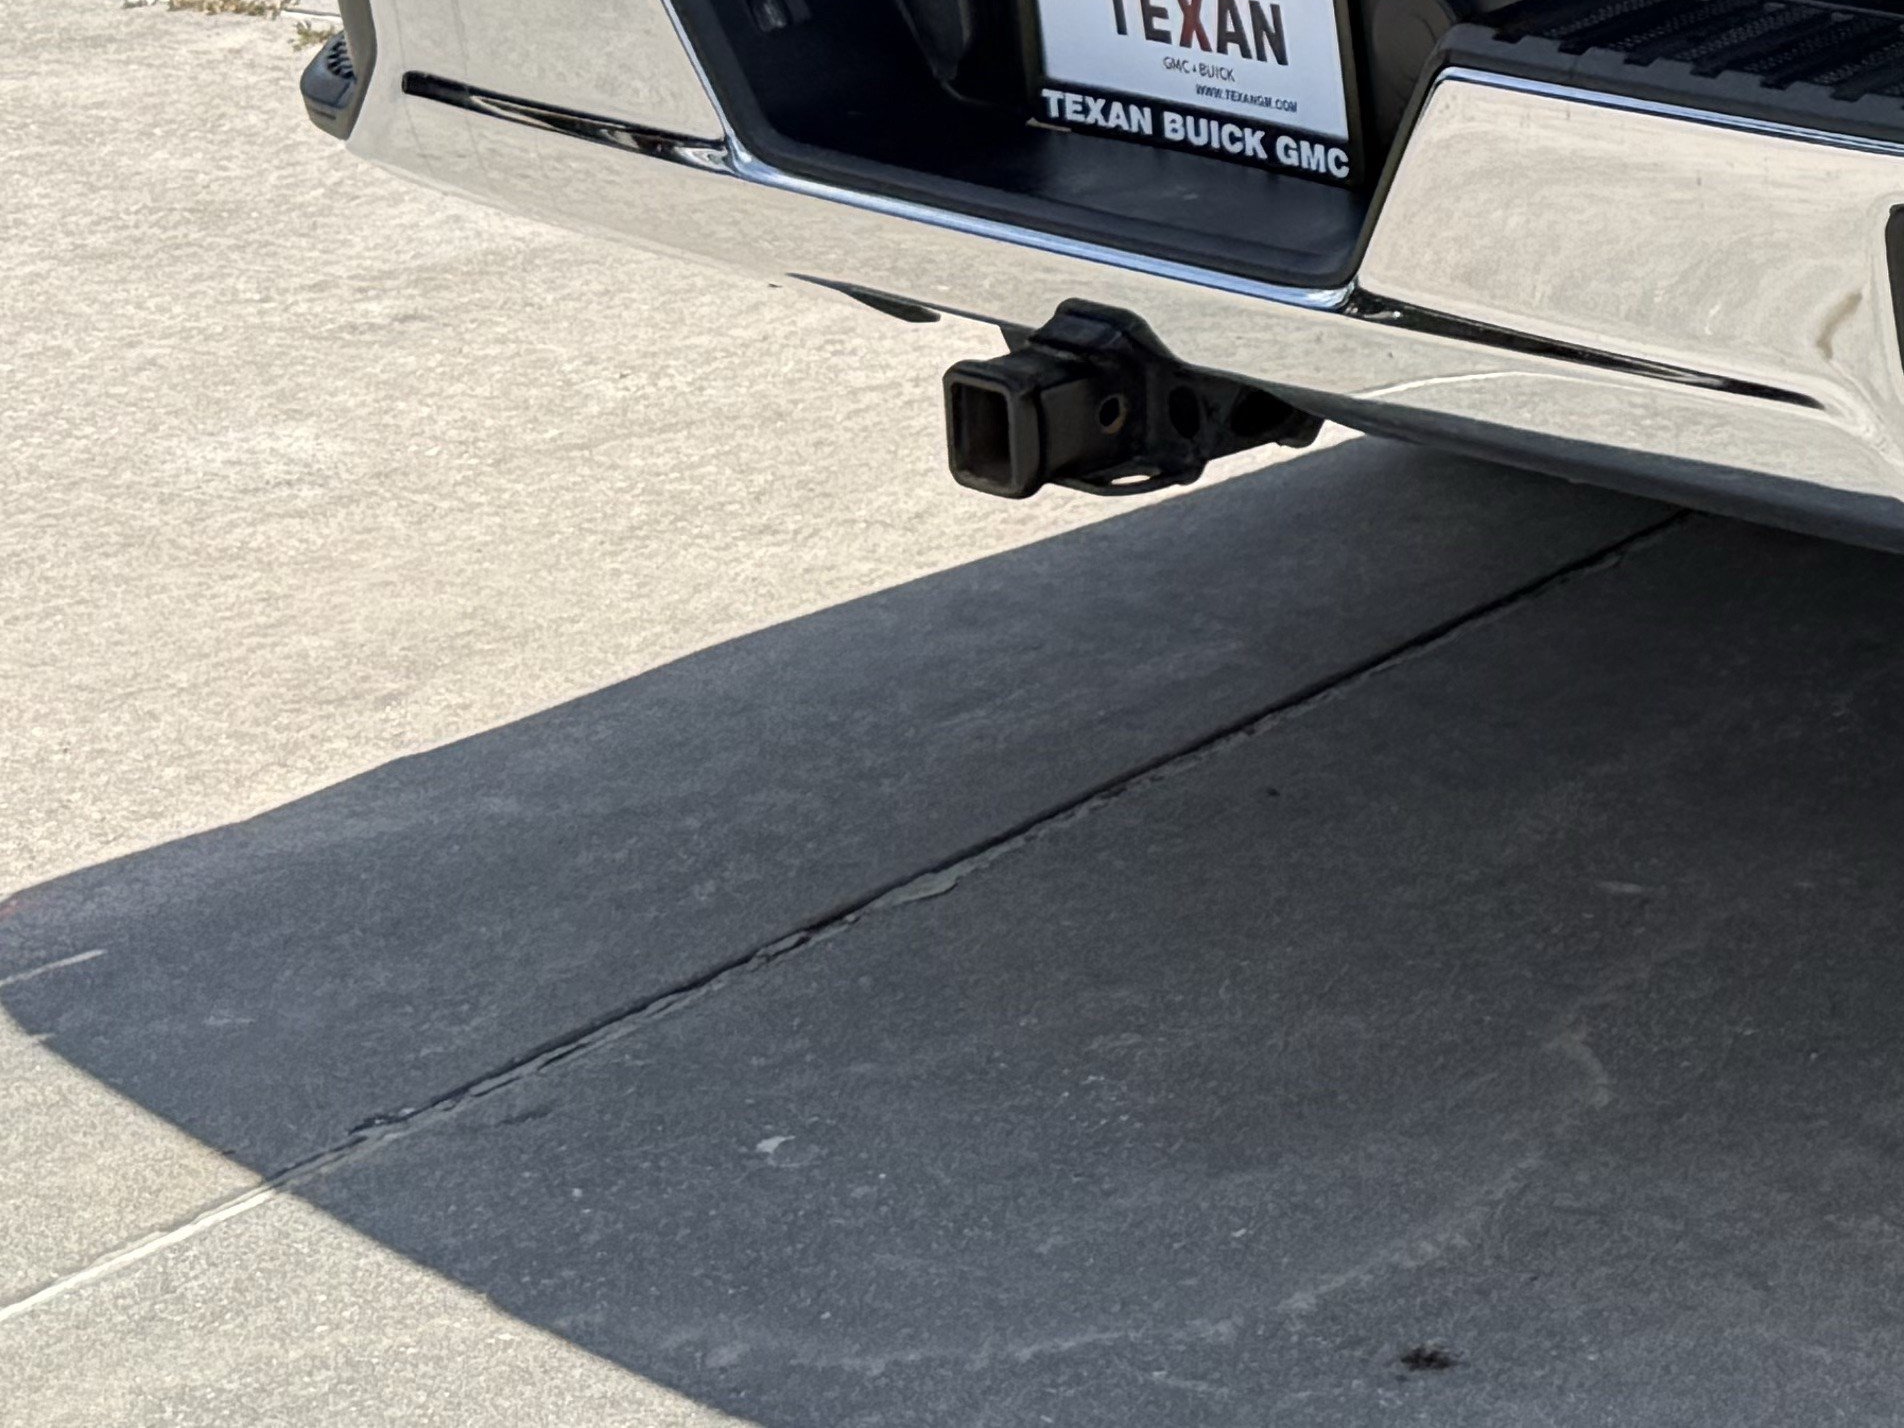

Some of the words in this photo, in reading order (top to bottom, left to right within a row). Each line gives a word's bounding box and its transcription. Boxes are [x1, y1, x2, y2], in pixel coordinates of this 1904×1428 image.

[1163, 56, 1190, 74] GMC
[1199, 63, 1235, 82] BUICK
[1042, 88, 1152, 135] TEXAN
[1163, 111, 1268, 160] BUICK
[1275, 135, 1350, 179] GMC
